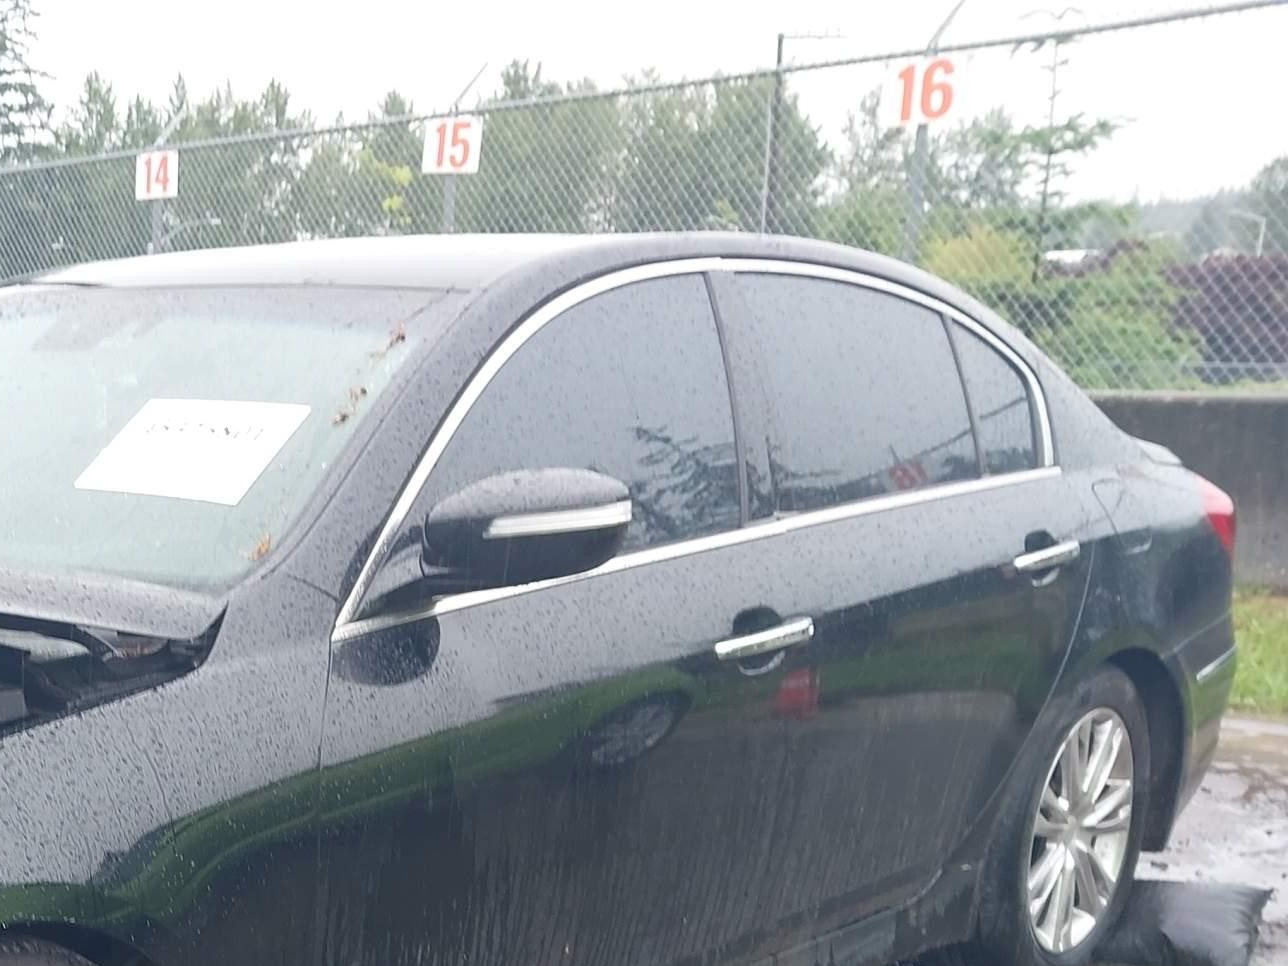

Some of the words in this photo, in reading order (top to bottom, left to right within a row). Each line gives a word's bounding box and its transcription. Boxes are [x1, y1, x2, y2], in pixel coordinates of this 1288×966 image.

[897, 58, 954, 121] 16
[436, 120, 471, 168] 15
[143, 154, 171, 194] 14
